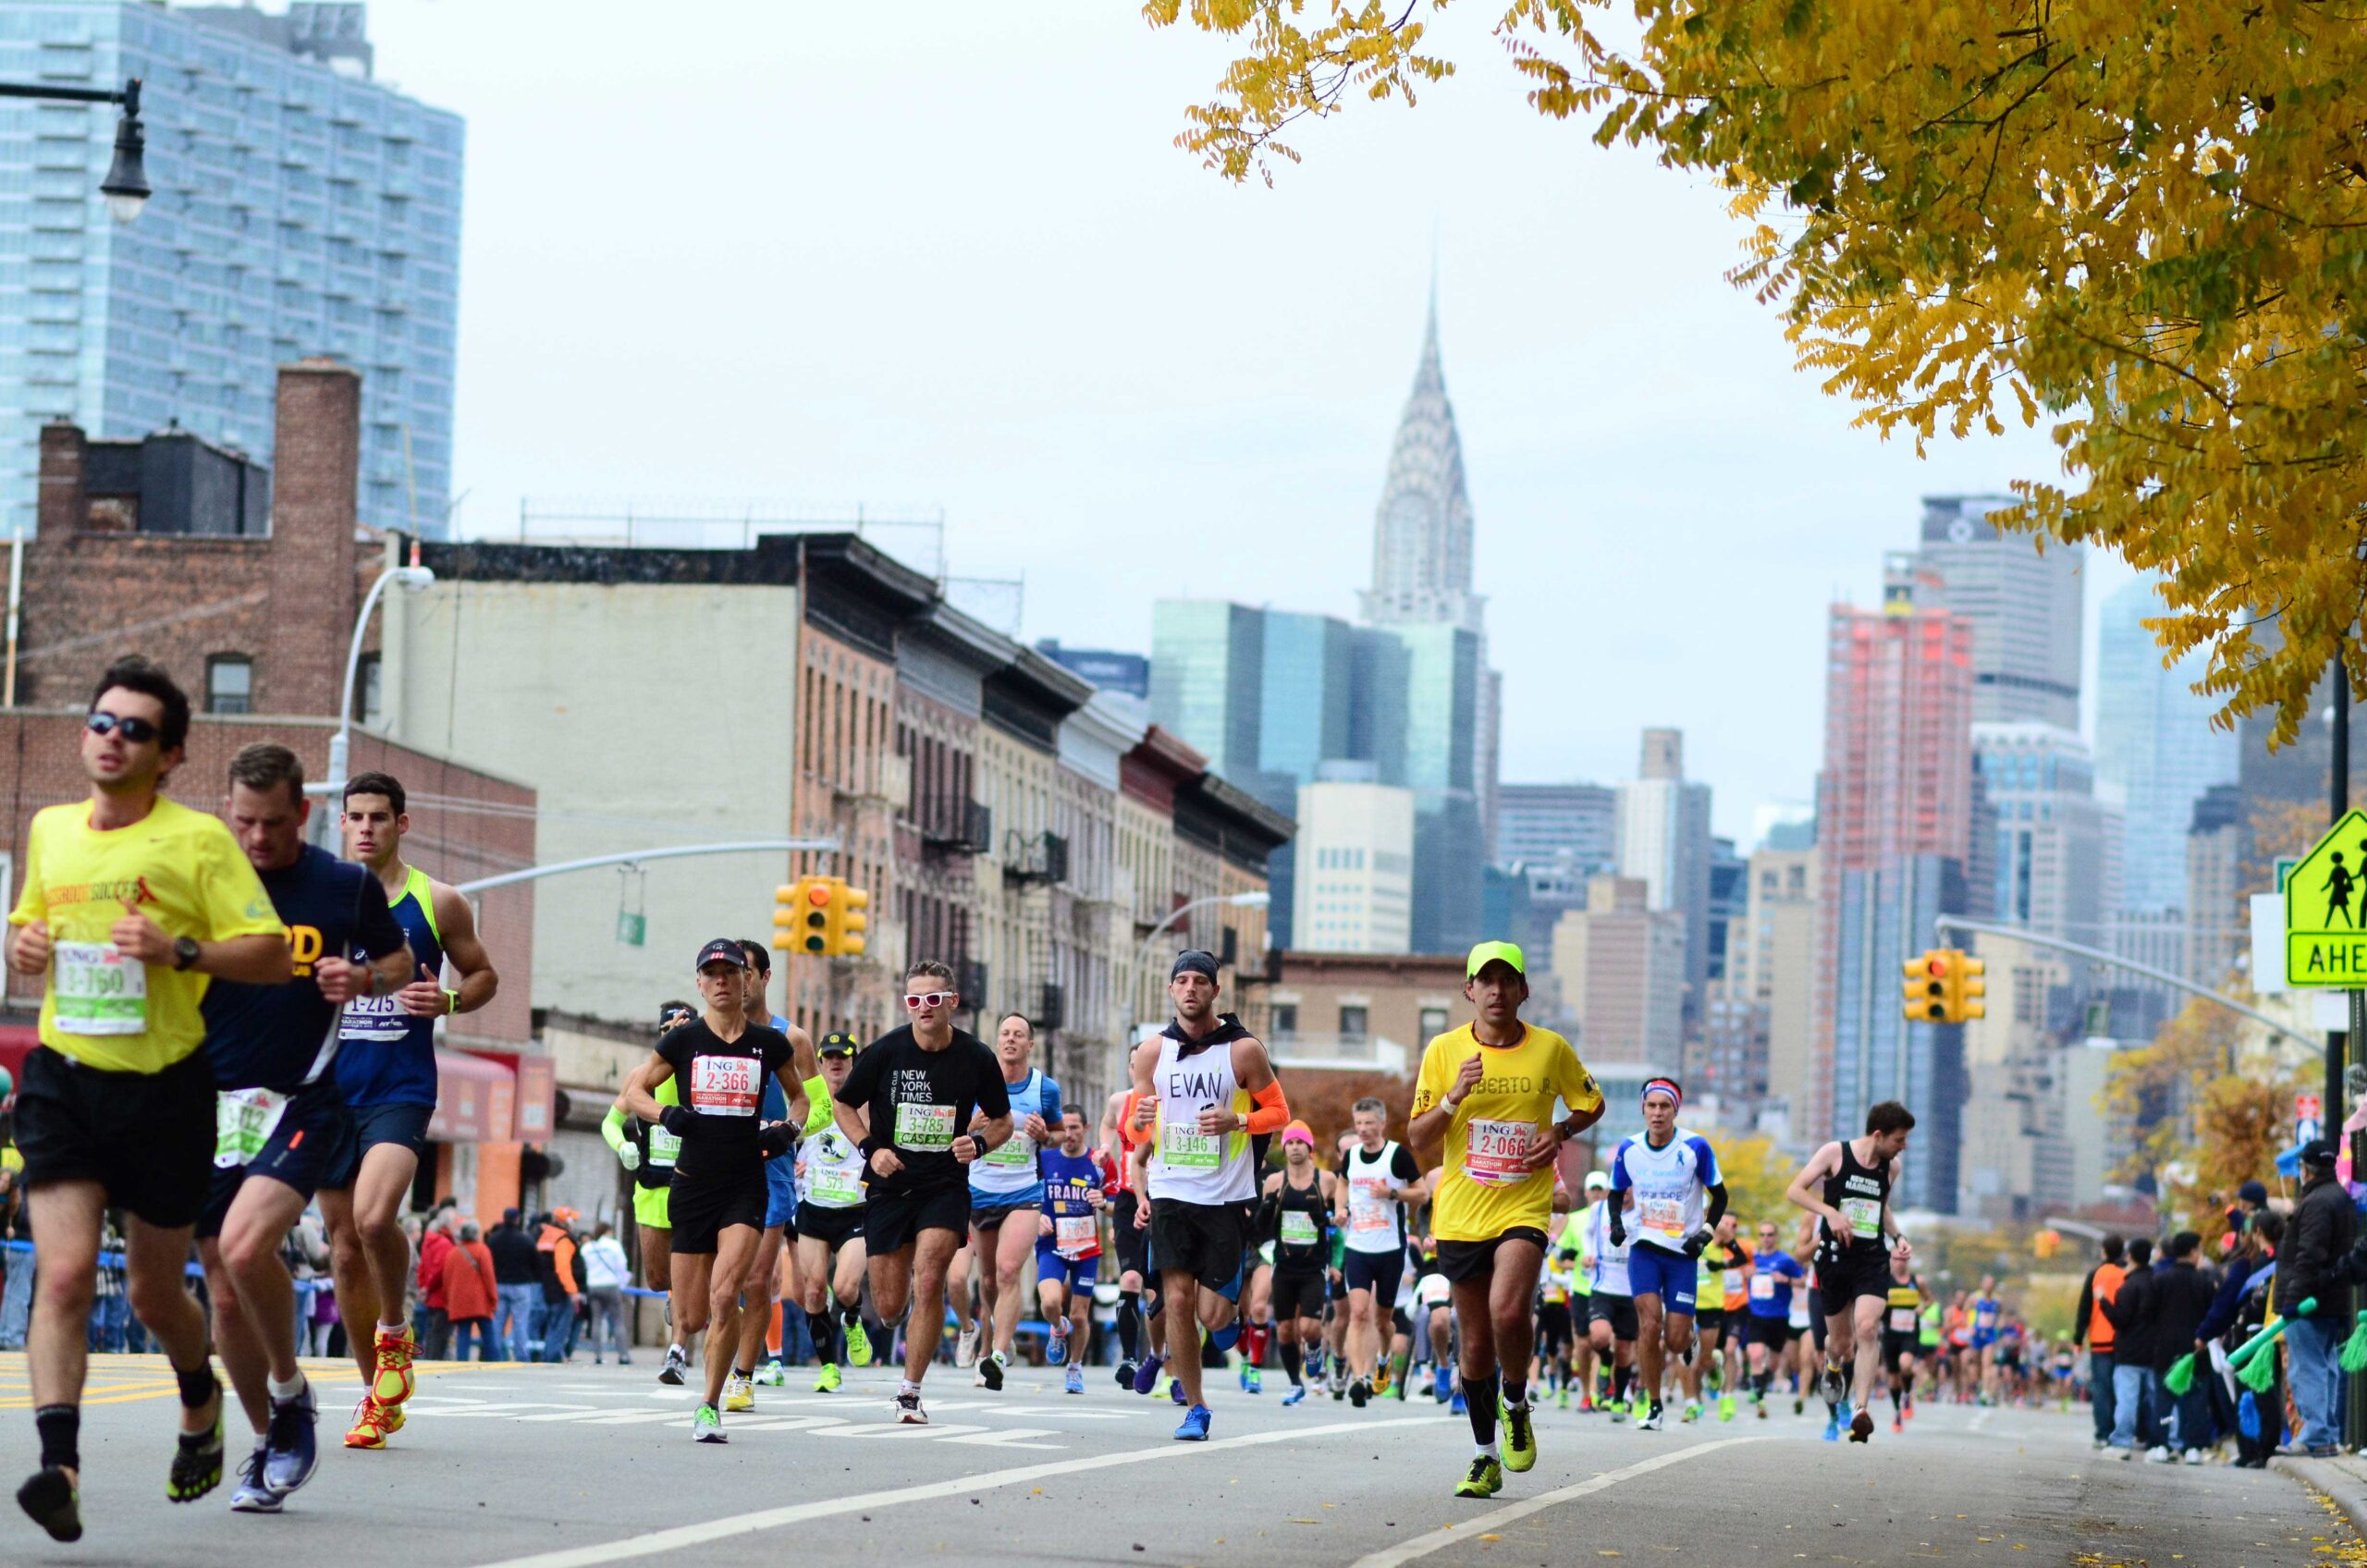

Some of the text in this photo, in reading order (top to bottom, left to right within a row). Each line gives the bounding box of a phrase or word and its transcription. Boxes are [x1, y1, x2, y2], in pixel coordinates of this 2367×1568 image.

[2308, 943, 2366, 973] AHE
[351, 996, 395, 1012] 1-275
[707, 1060, 732, 1071] ING
[706, 1072, 749, 1091] 2-366
[901, 1070, 926, 1080] NEW
[901, 1081, 931, 1091] YORK
[1171, 1072, 1222, 1099] EVAN
[1471, 1076, 1531, 1095] BERTO
[901, 1092, 933, 1102] TIMES
[1417, 1095, 1430, 1109] 13
[909, 1108, 931, 1117] ING
[909, 1117, 944, 1133] 3-785
[1175, 1126, 1195, 1135] ING
[1482, 1124, 1510, 1135] ING
[665, 1137, 681, 1149] 576
[901, 1133, 941, 1145] CASEY
[1176, 1136, 1208, 1152] 3-146
[1481, 1134, 1526, 1156] 2-066
[1000, 1140, 1022, 1153] -254
[1471, 1158, 1502, 1168] MARATHON
[827, 1177, 843, 1190] 573
[1850, 1174, 1879, 1187] NEW YORK
[1048, 1184, 1088, 1201] FRANC
[1853, 1208, 1869, 1220] 762
